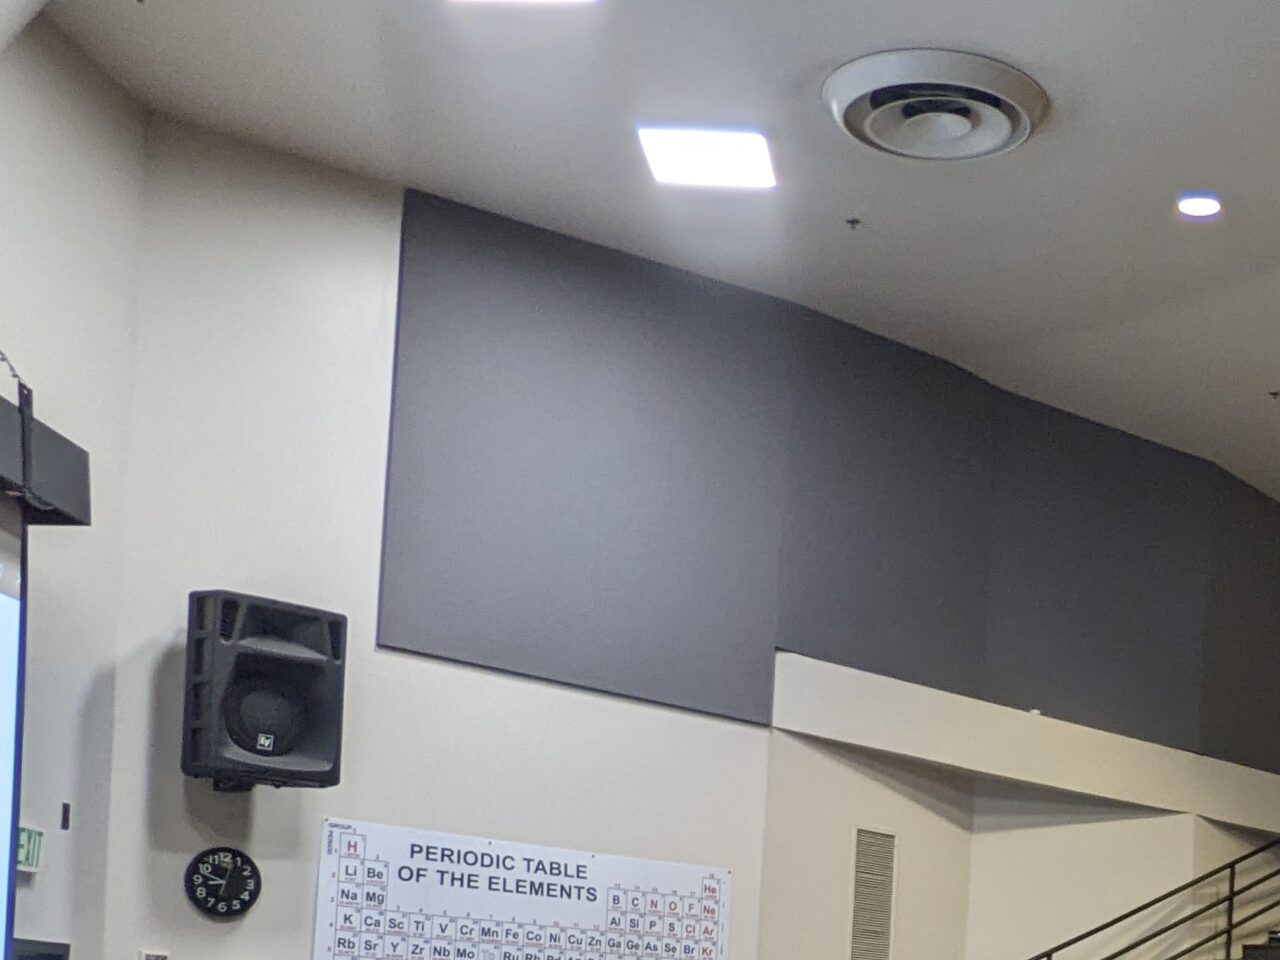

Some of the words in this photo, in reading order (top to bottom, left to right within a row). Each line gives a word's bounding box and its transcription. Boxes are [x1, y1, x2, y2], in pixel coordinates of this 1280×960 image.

[348, 840, 357, 852] H
[209, 855, 218, 864] 11
[236, 857, 241, 866] 1
[410, 843, 516, 871] PERIODIC
[522, 858, 588, 880] TABLE
[199, 863, 211, 873] 10
[242, 866, 251, 876] 2
[345, 865, 357, 877] Li
[367, 868, 384, 879] Be
[193, 875, 202, 884] 9
[398, 866, 428, 882] OF
[436, 870, 480, 889] THE
[488, 876, 598, 902] ELEMENTS
[247, 880, 254, 890] 3
[704, 884, 717, 894] He
[196, 887, 206, 898] 8
[240, 891, 249, 901] 4
[341, 889, 358, 900] Na
[366, 892, 385, 904] Mg
[207, 898, 215, 907] 7
[218, 902, 227, 912] 6
[232, 900, 240, 910] 5
[613, 895, 620, 905] B
[632, 898, 639, 907] C
[651, 900, 658, 909] N
[669, 902, 677, 911] O
[688, 903, 694, 912] F
[703, 906, 715, 915] Ne
[610, 917, 620, 926] Al
[629, 919, 639, 928] Si
[650, 921, 656, 930] P
[668, 922, 675, 932] S
[685, 924, 695, 934] Cl
[703, 926, 714, 936] Ar
[344, 914, 353, 924] K
[364, 916, 381, 928] Ca
[388, 918, 404, 930] Sc
[414, 921, 424, 931] Ti
[439, 923, 448, 933] V
[460, 925, 474, 936] Cr
[481, 928, 499, 938] Mn
[505, 929, 519, 939] Fe
[526, 931, 542, 942] Co
[550, 933, 560, 943] Ni
[568, 935, 582, 945] Cu
[588, 937, 601, 946] Zn
[608, 939, 621, 948] Ga
[626, 941, 640, 950] Ge
[645, 942, 658, 951] As
[664, 943, 677, 953] Se
[684, 945, 695, 954] Br
[702, 946, 713, 956] Kr
[337, 938, 355, 950] Rb
[364, 940, 378, 951] Sr
[390, 942, 400, 952] Y
[411, 944, 425, 955] Zr
[433, 946, 450, 957] Nb
[456, 948, 475, 959] Mo
